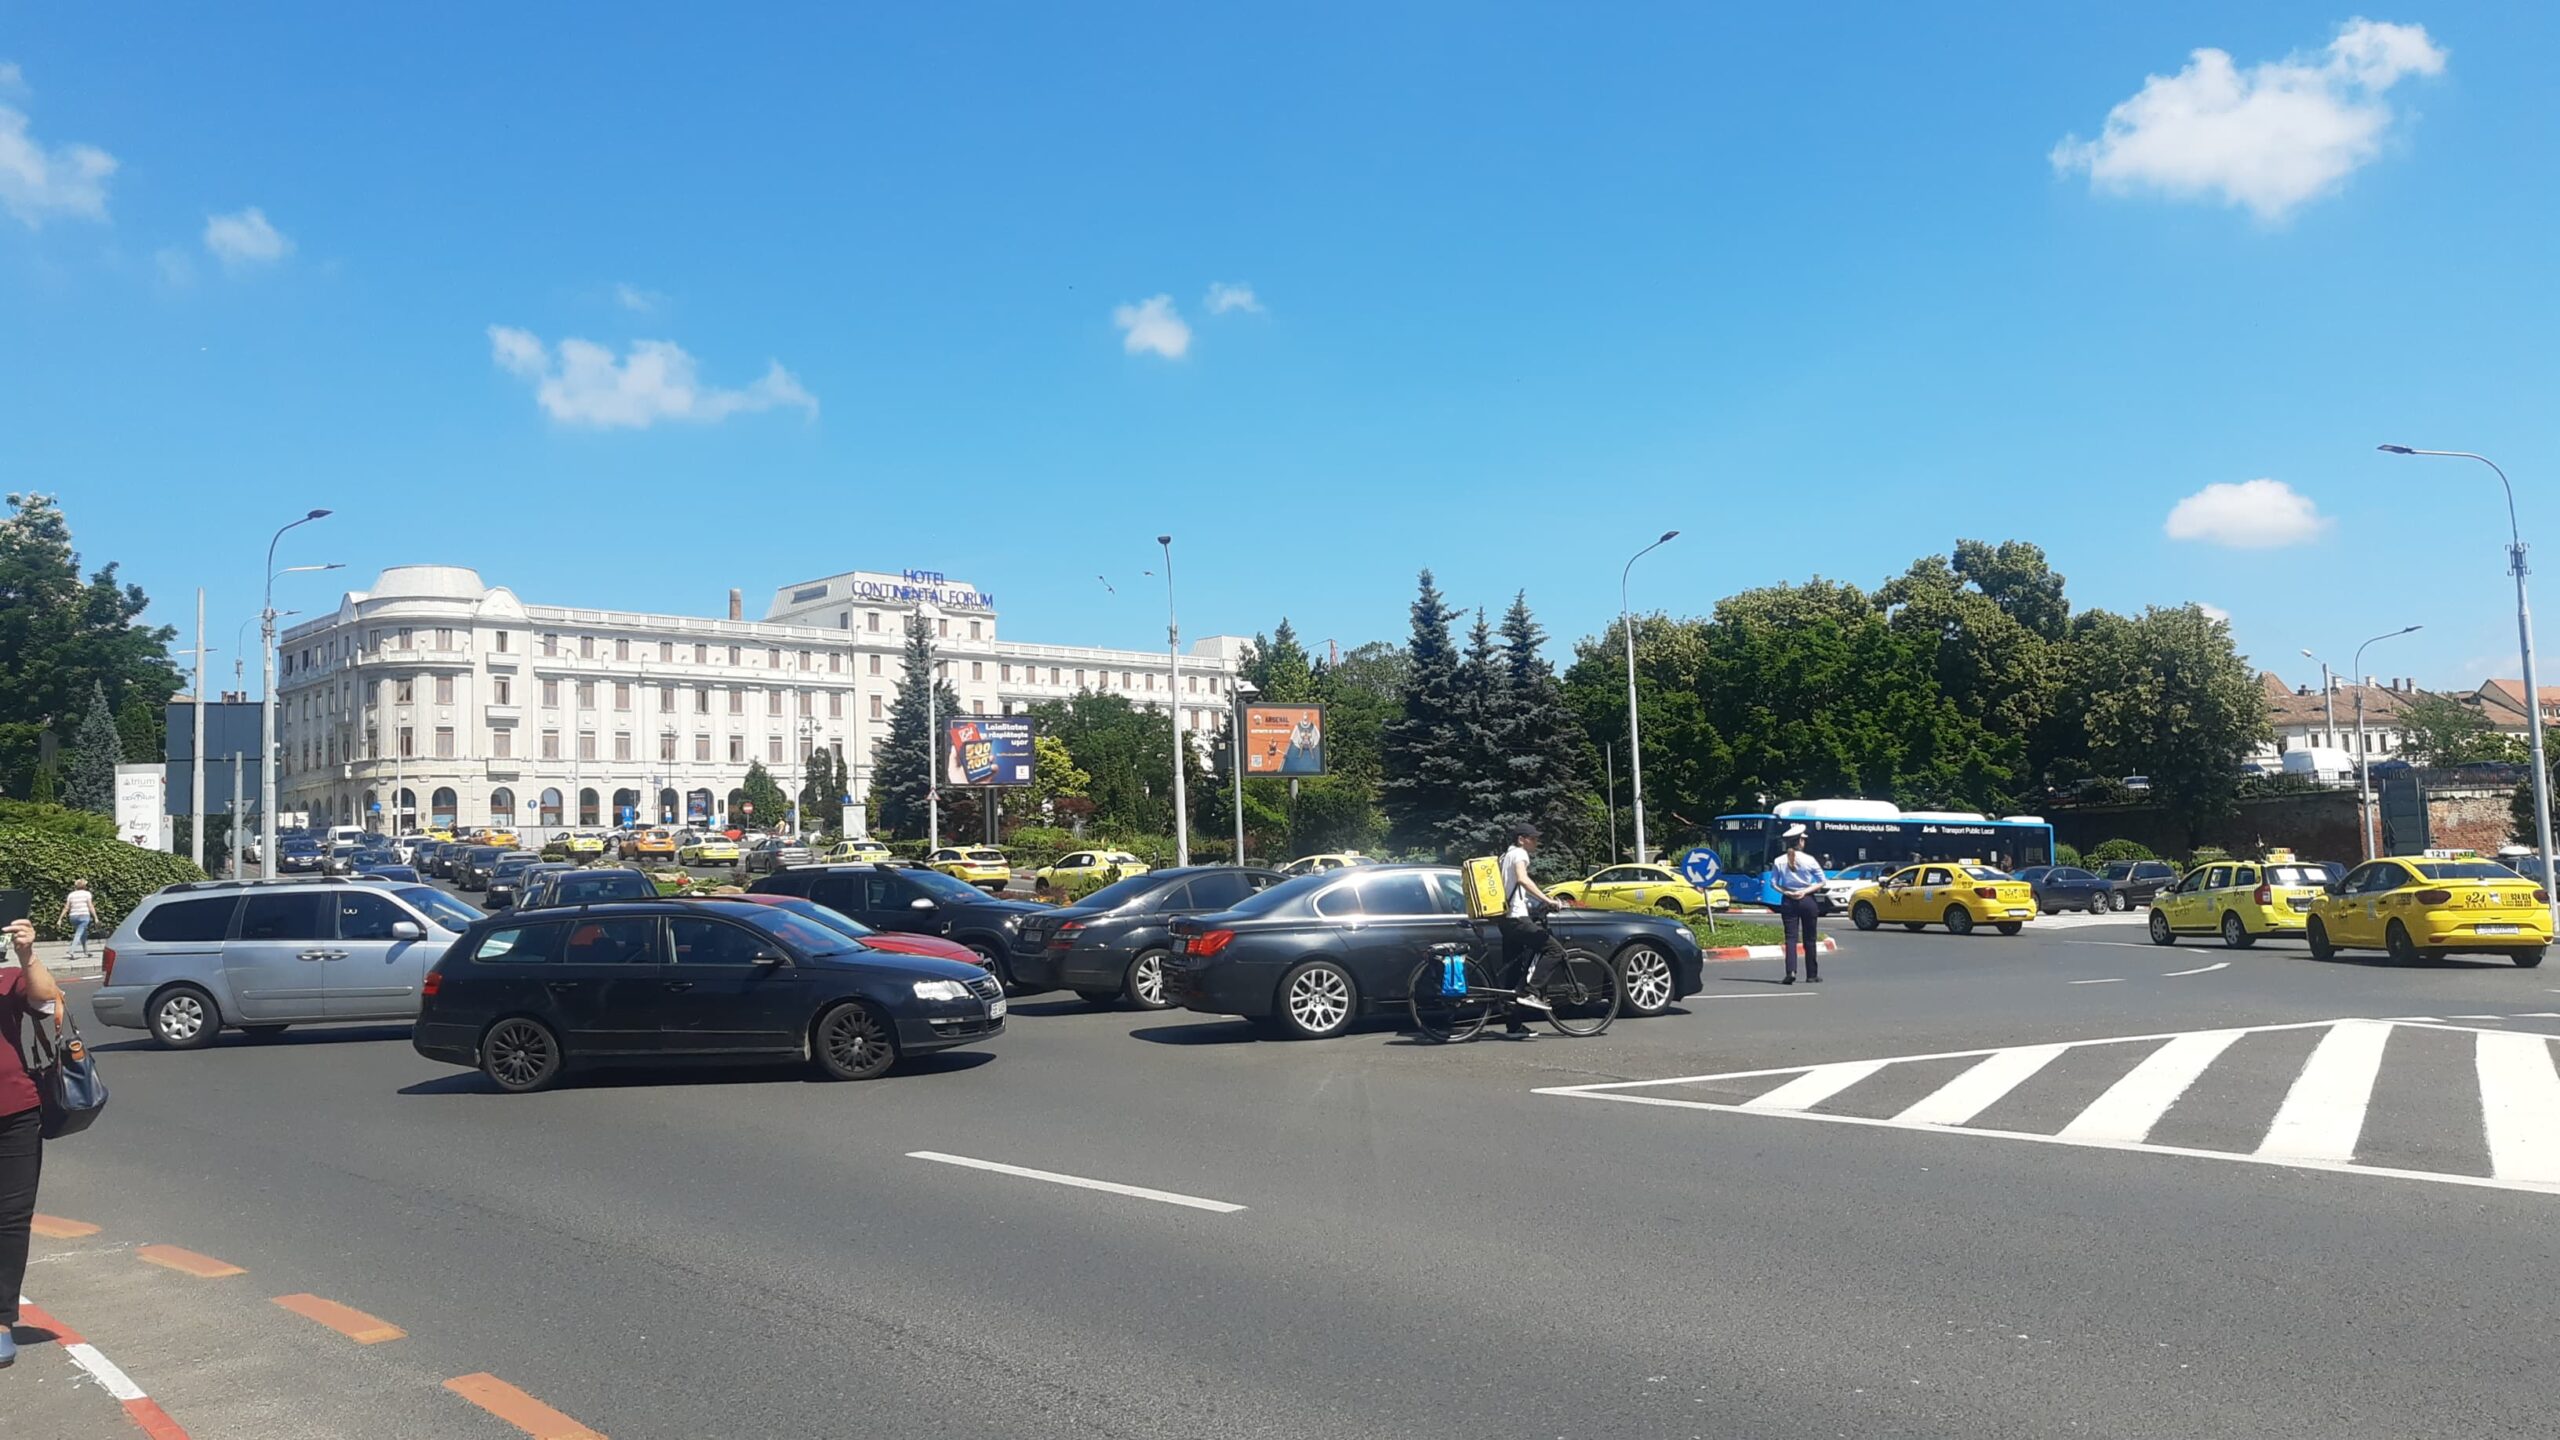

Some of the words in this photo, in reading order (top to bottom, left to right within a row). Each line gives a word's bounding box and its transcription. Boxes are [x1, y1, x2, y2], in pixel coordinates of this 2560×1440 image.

[903, 569, 946, 586] HOTEL
[852, 581, 946, 605] CONTINENTAL
[949, 590, 993, 608] FORUM
[1941, 826, 1965, 835] Transport
[1965, 827, 1981, 835] Public
[2465, 891, 2486, 903] 924
